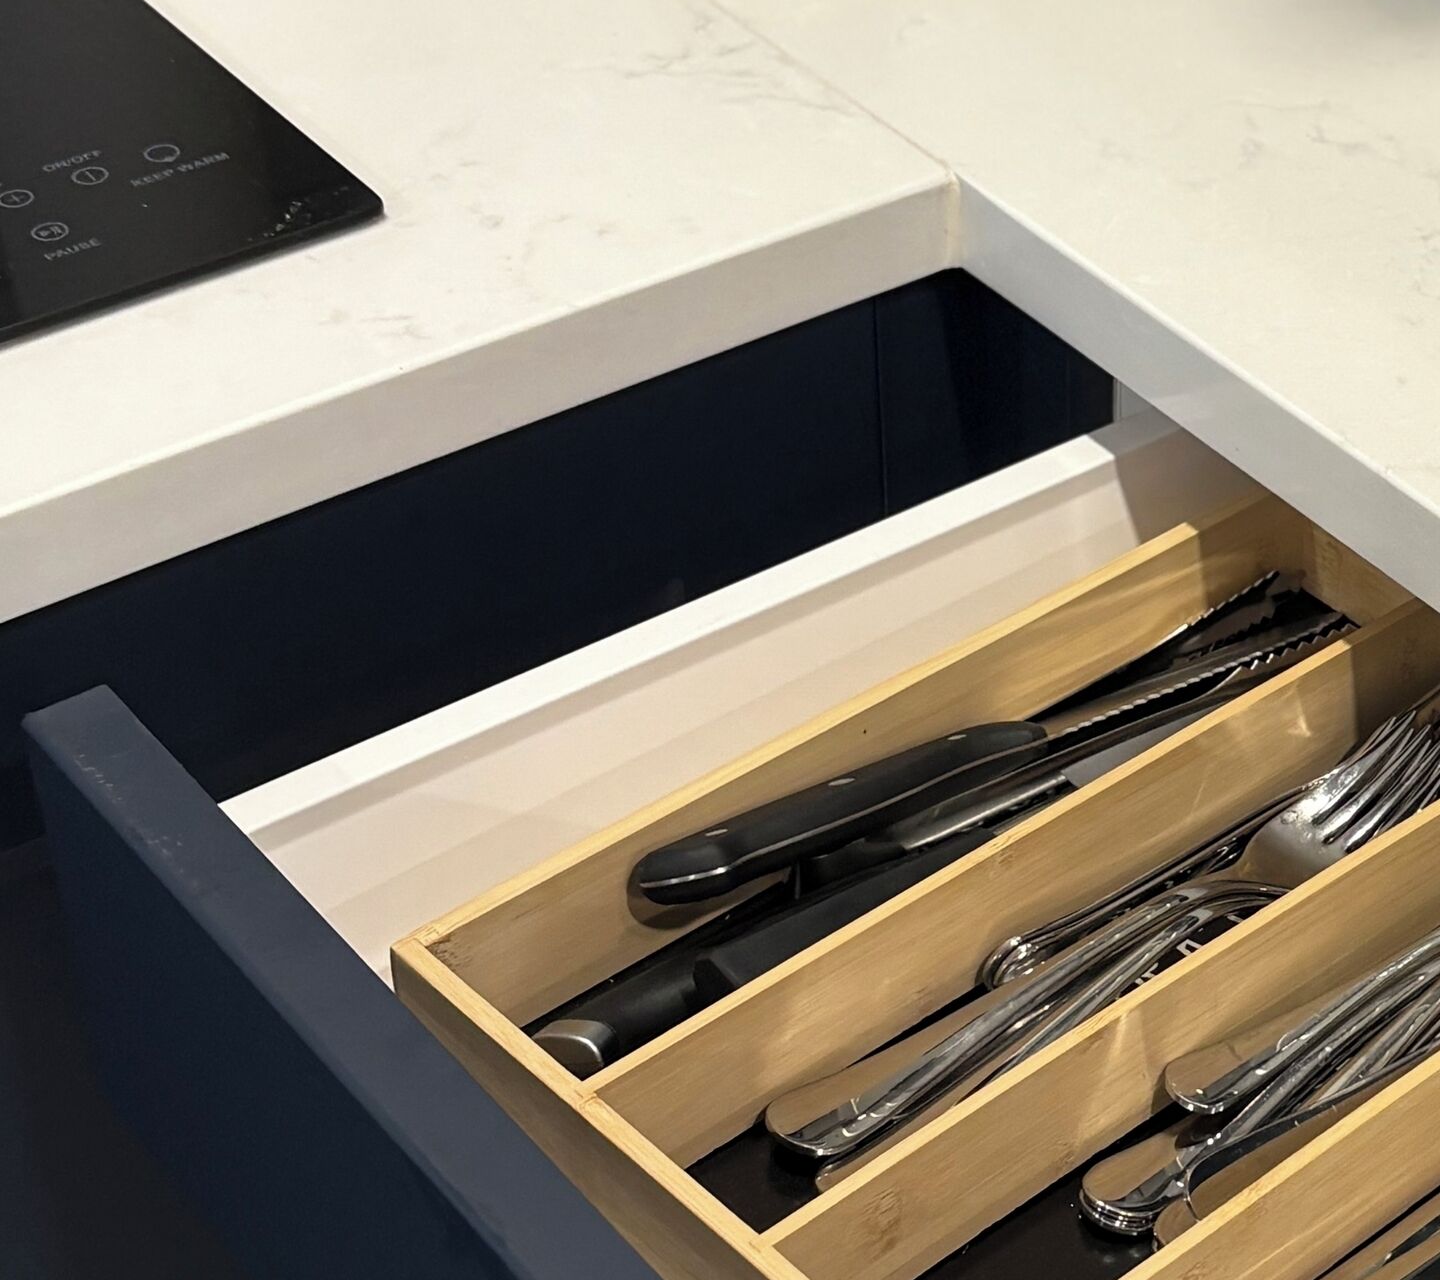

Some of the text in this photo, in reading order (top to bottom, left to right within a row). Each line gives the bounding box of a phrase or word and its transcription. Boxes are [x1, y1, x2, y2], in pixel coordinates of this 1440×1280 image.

[43, 150, 102, 172] ON/OFF
[130, 151, 230, 187] KEEP WARM
[44, 237, 102, 260] PAUSE
